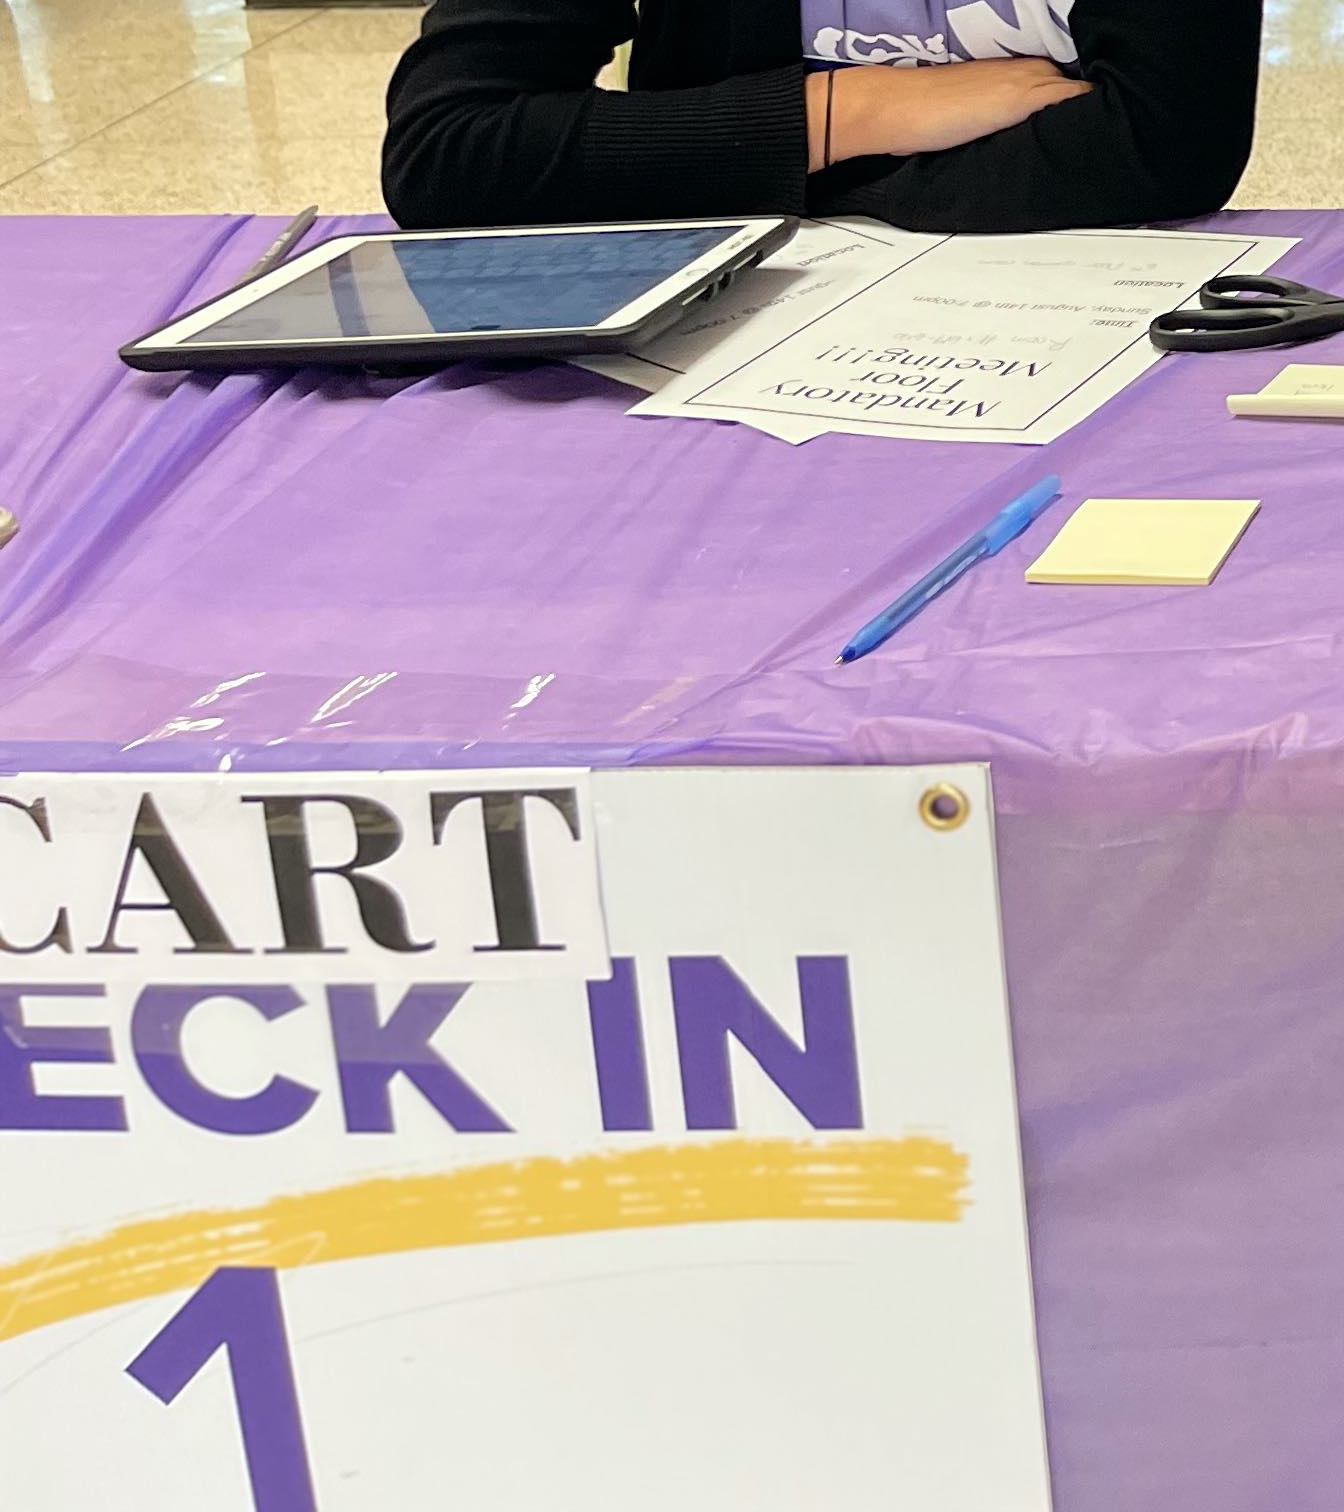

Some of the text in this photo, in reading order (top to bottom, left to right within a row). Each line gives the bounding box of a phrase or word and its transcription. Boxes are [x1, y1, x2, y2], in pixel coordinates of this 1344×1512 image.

[970, 300, 991, 311] @
[1034, 302, 1088, 314] August
[1090, 318, 1140, 329] Time:
[815, 344, 1054, 378] Meeting!!!
[859, 369, 966, 395] Floor
[762, 380, 1003, 419] Mandatory
[586, 953, 866, 1133] IN
[124, 1265, 321, 1512] 1
